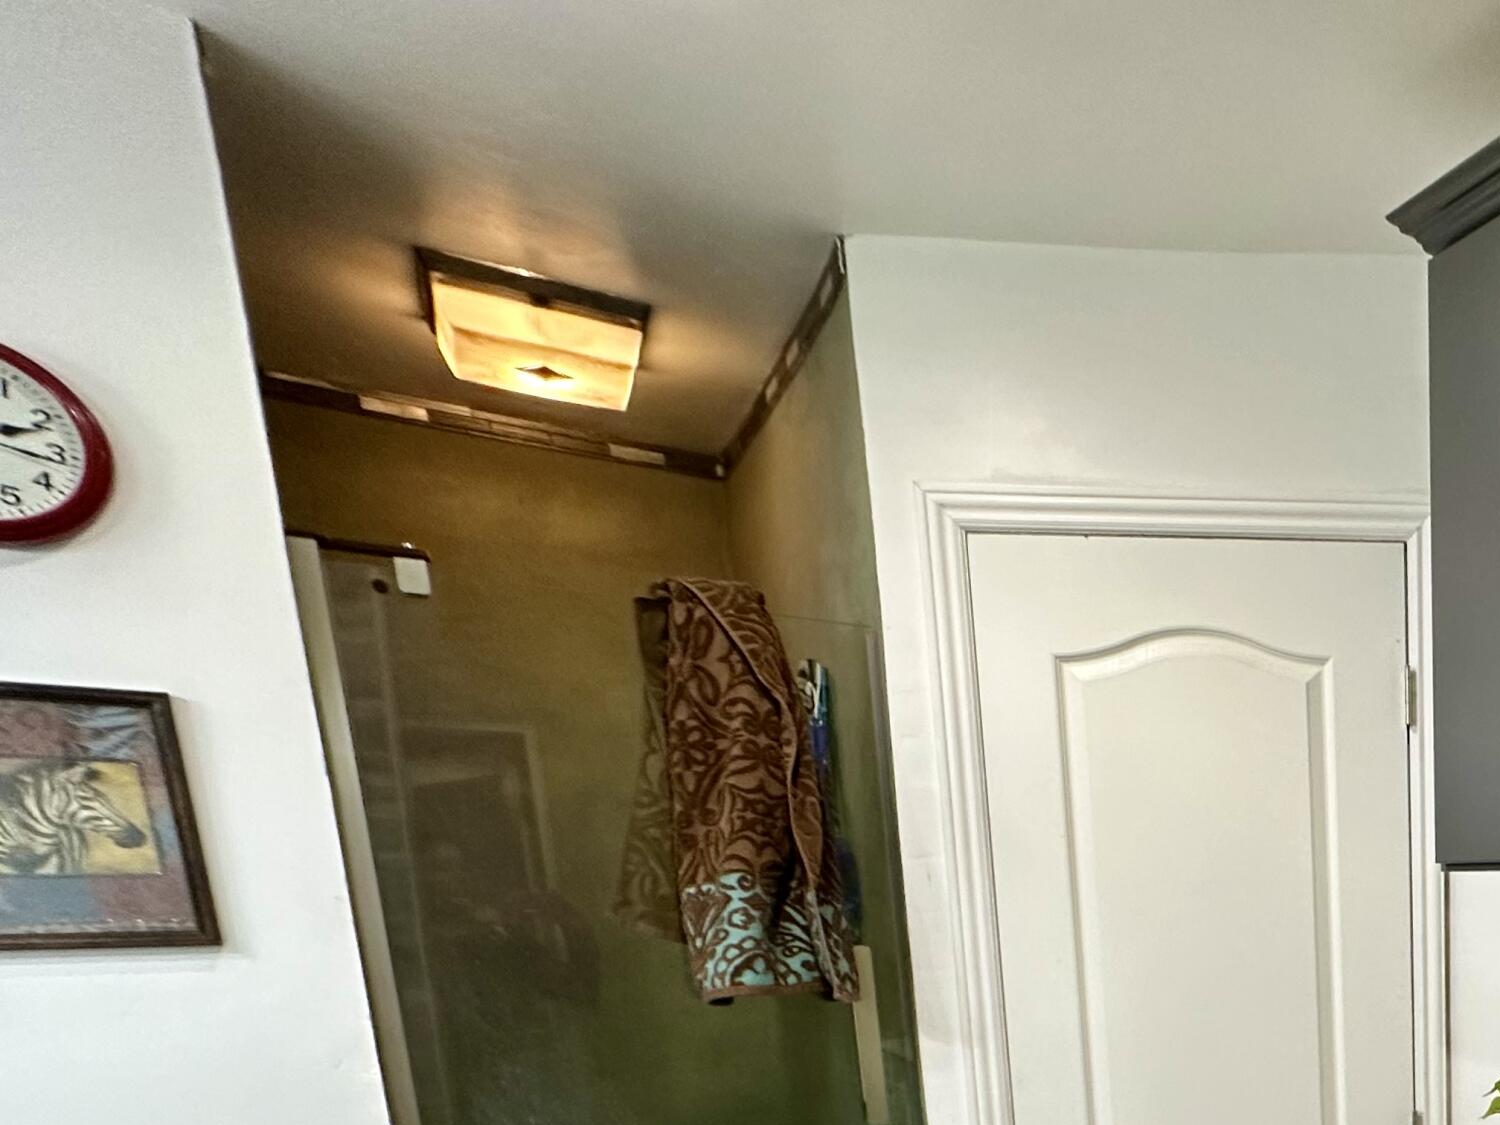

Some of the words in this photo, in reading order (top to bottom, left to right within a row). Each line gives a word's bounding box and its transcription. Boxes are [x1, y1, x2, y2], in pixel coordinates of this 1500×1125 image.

[30, 408, 53, 431] 2
[46, 442, 67, 465] 3
[33, 471, 56, 493] 4
[0, 484, 21, 506] 5
